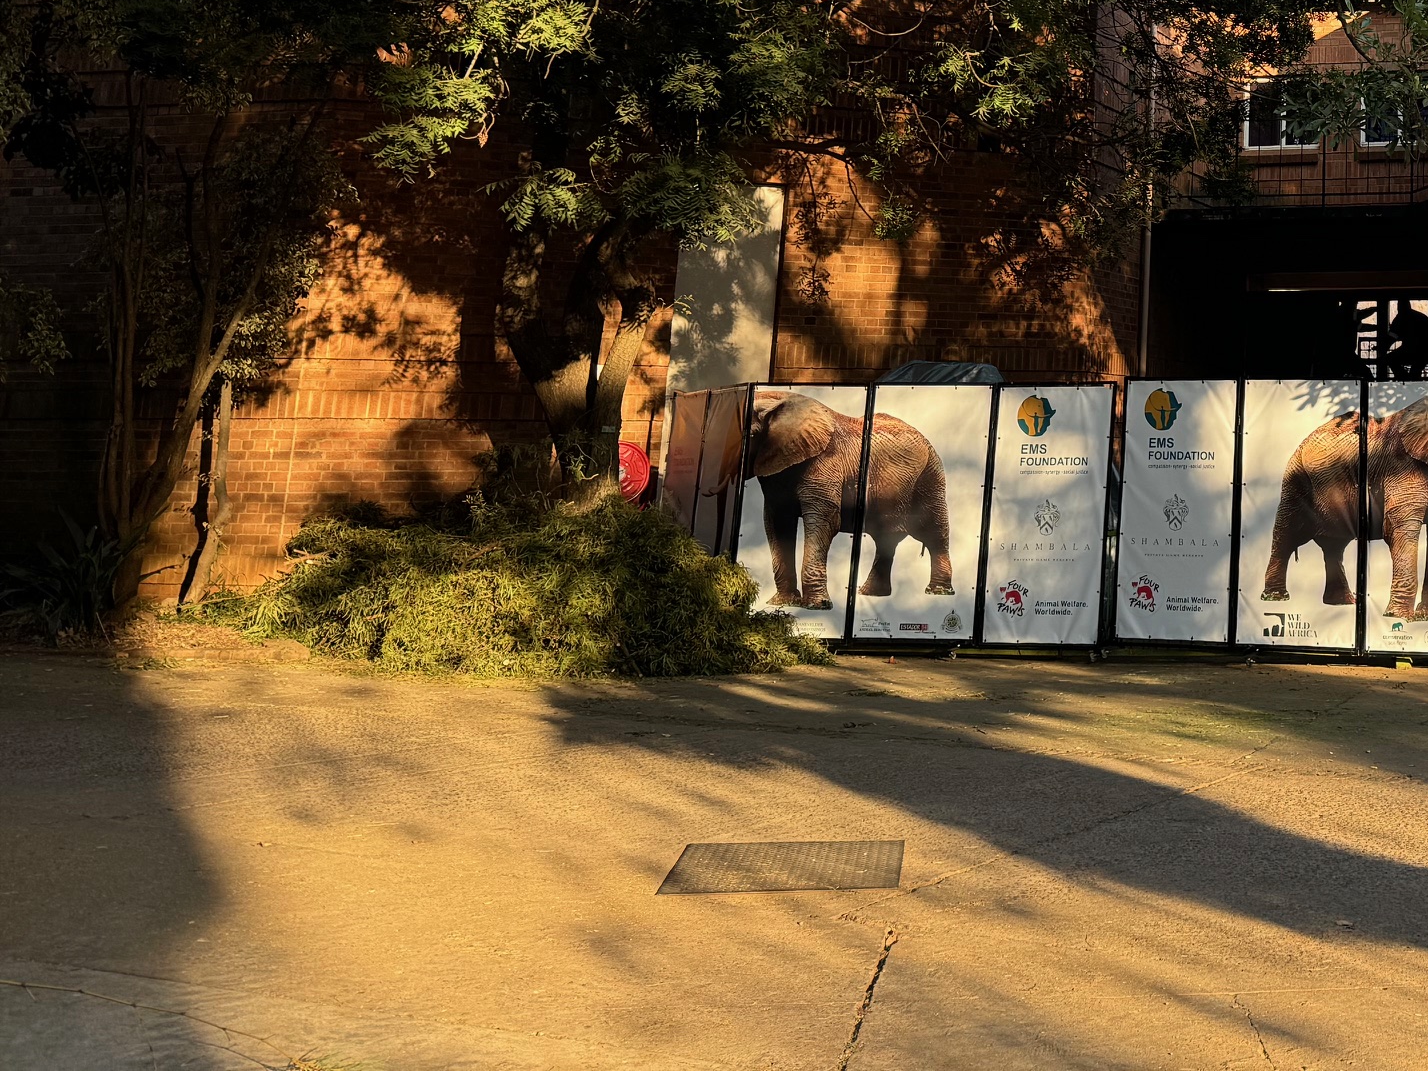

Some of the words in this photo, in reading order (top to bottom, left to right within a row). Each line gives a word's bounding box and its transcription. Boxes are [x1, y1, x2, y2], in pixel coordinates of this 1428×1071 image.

[1149, 437, 1174, 448] EMS
[1021, 444, 1047, 454] EMS
[1148, 451, 1215, 460] FOUNDATION
[1020, 457, 1088, 466] FOUNDATION
[1000, 542, 1091, 551] SHAMBALA
[1131, 537, 1219, 547] SHAMBALA
[1007, 579, 1029, 597] FOUR
[1138, 574, 1160, 593] FOUR
[1034, 600, 1059, 608] Animal
[1166, 596, 1190, 604] Animal
[1190, 596, 1219, 604] Welfare.
[997, 602, 1025, 617] PAWS
[1129, 597, 1156, 613] PAWS
[1166, 604, 1203, 612] Worldwide.
[1034, 608, 1073, 616] Worldwide.
[1287, 613, 1302, 621] WE
[1287, 621, 1311, 630] WILD
[1286, 629, 1318, 638] AFRICA
